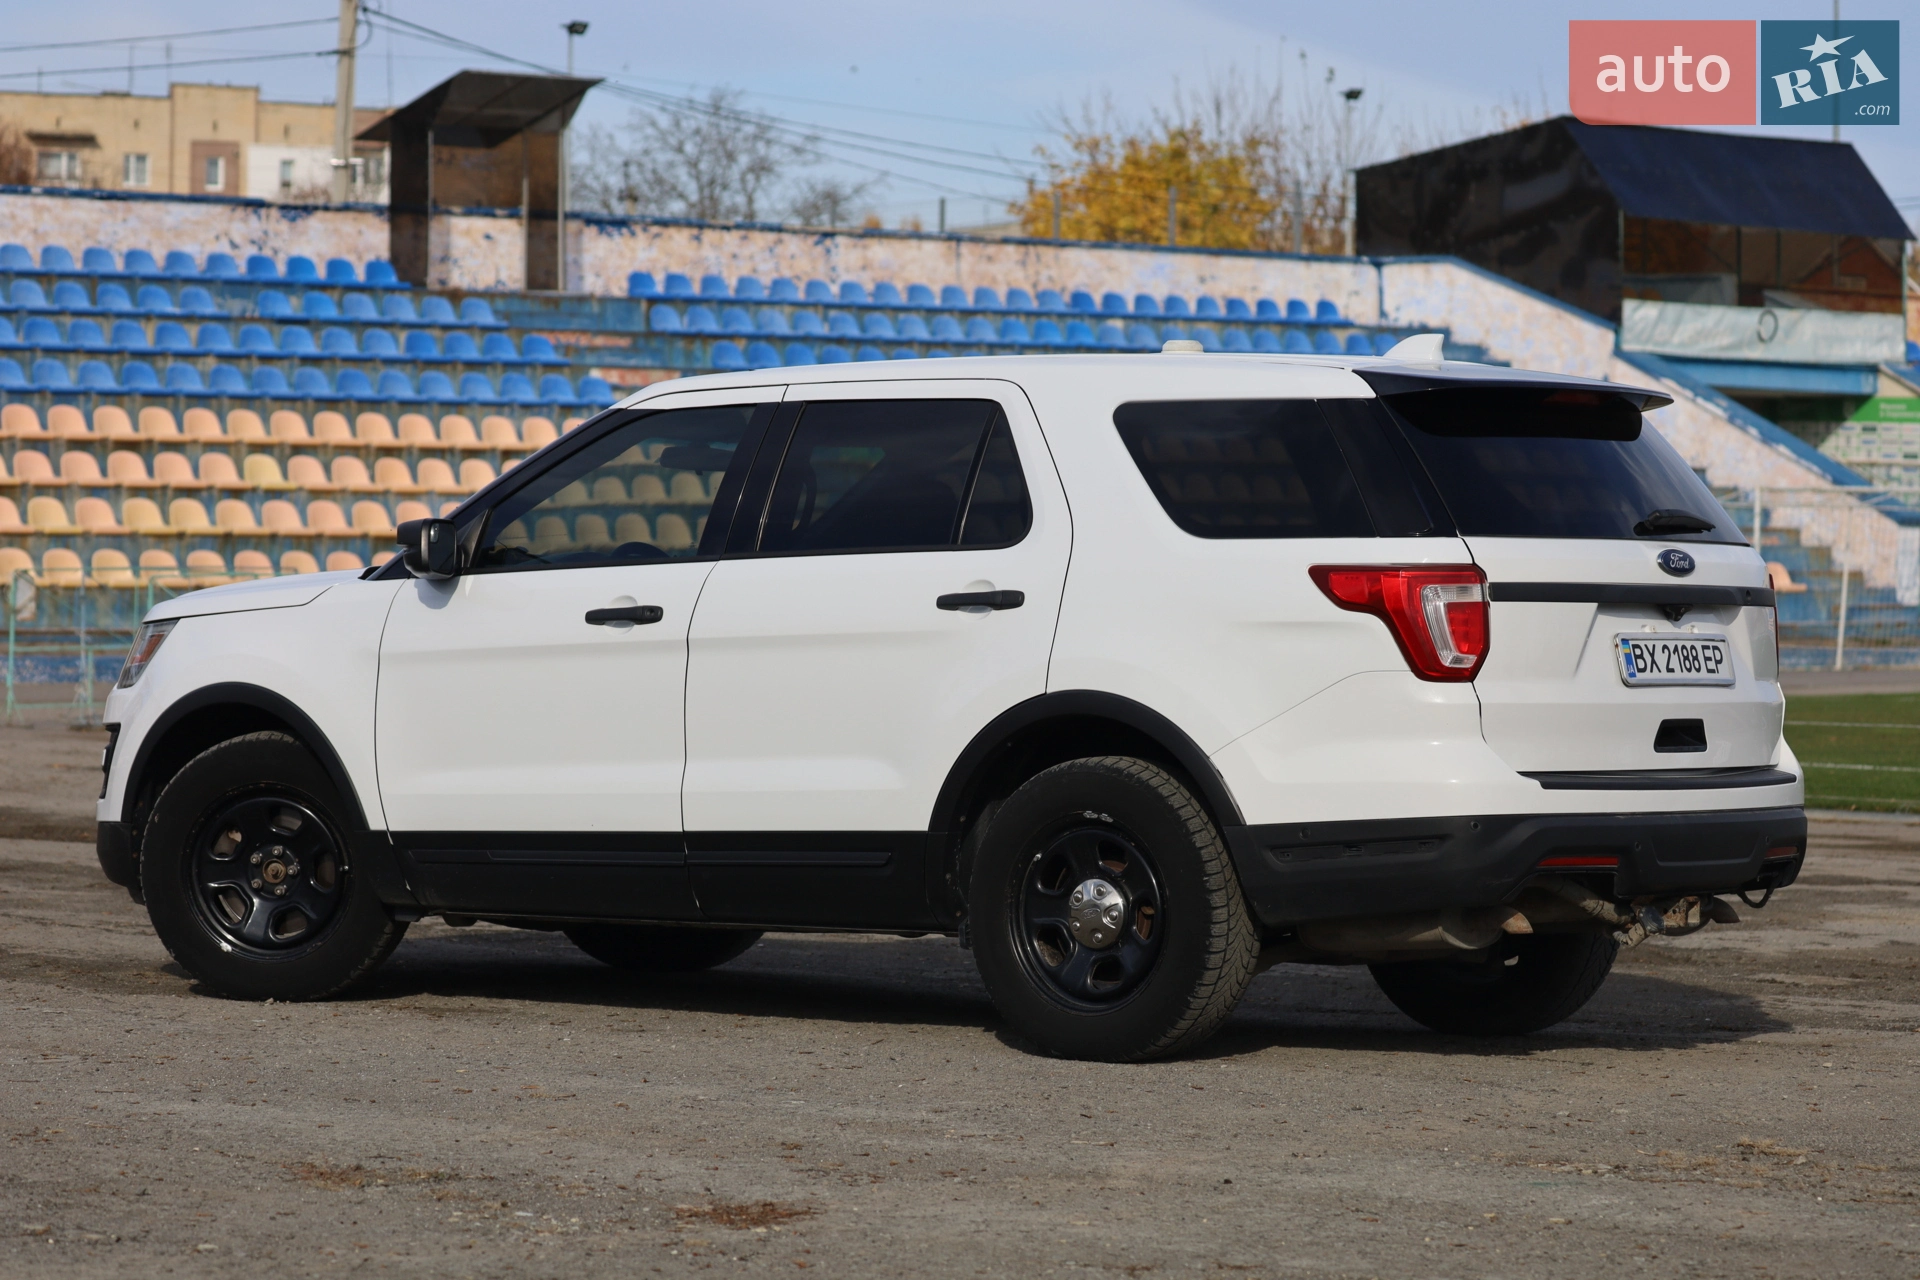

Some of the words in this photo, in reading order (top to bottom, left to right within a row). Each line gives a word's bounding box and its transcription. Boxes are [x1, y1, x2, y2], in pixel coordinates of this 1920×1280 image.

[1669, 552, 1690, 569] Ford
[1631, 643, 1662, 674] BX
[1661, 643, 1702, 674] 2188
[1701, 644, 1724, 674] EP
